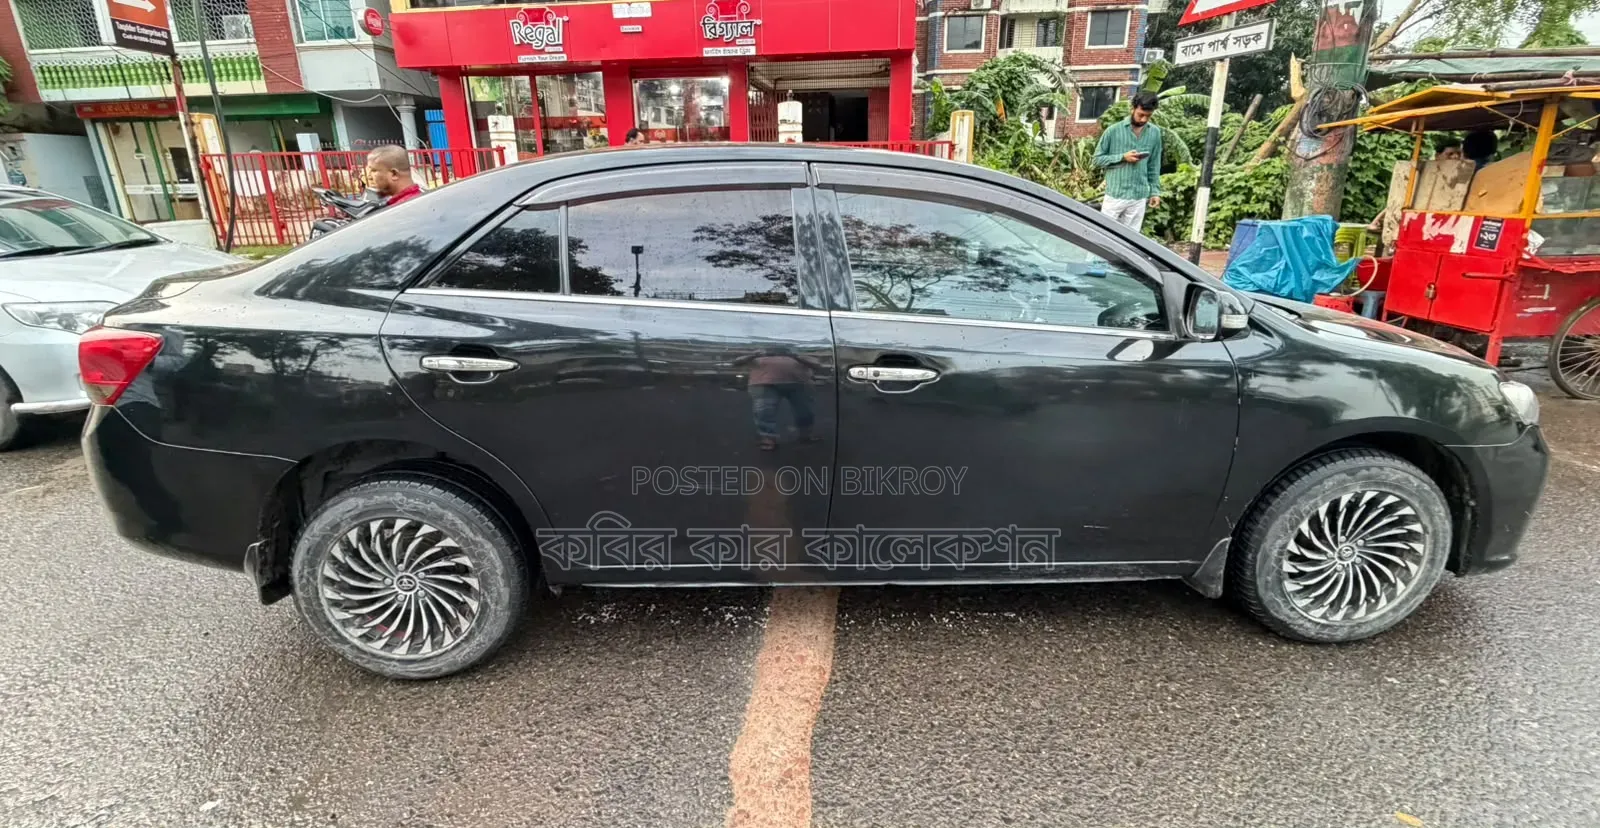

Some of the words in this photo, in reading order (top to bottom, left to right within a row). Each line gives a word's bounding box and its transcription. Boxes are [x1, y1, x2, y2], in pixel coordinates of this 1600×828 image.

[509, 17, 563, 50] Regal
[700, 14, 756, 42] রিগ্যাল
[1181, 42, 1205, 57] বামে
[1233, 31, 1264, 48] সড়ক
